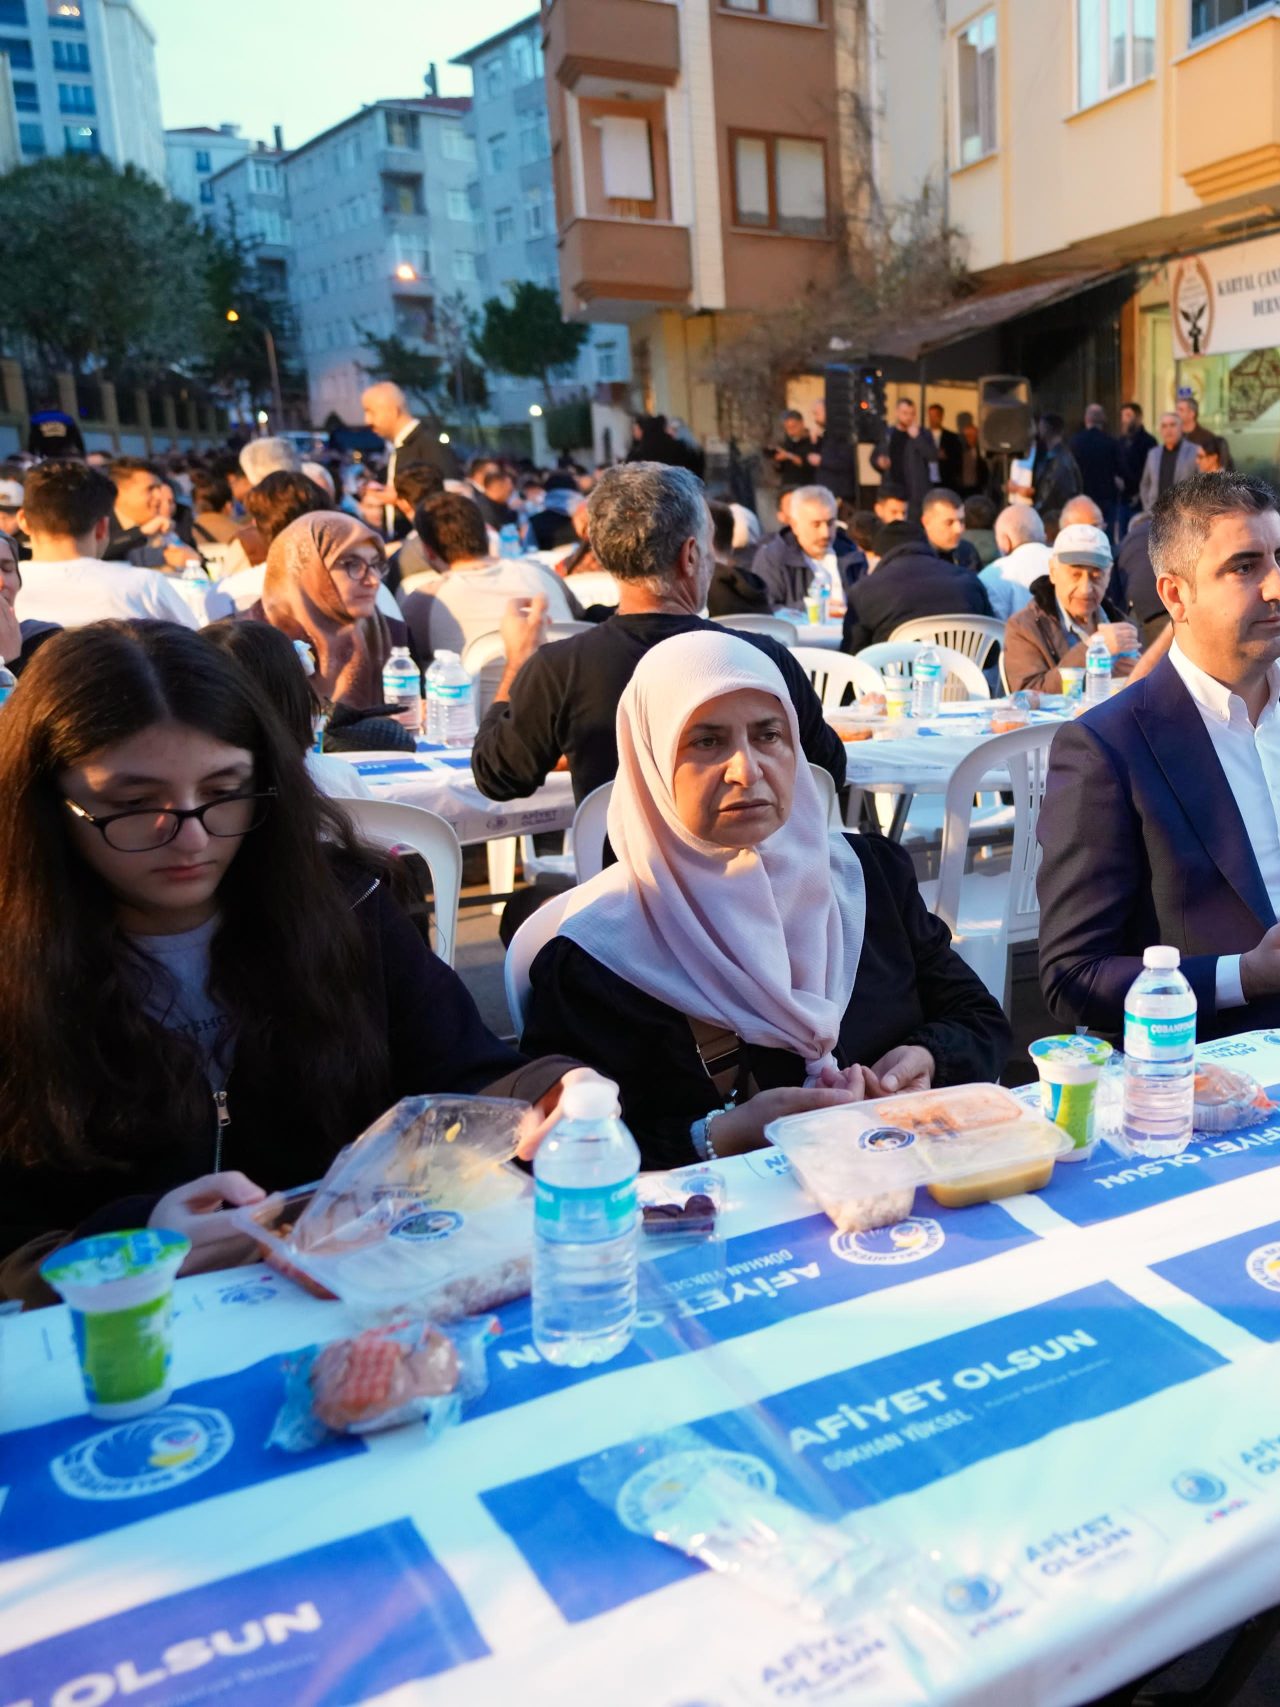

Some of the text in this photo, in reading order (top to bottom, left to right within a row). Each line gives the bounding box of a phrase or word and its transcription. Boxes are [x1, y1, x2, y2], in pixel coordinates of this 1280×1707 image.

[1217, 274, 1256, 297] KARTAL
[1094, 1153, 1202, 1190] OLSUN
[677, 1261, 821, 1319] AFİYET
[787, 1328, 1098, 1453] AFİYET OLSUN
[52, 1600, 323, 1707] OLSUN
